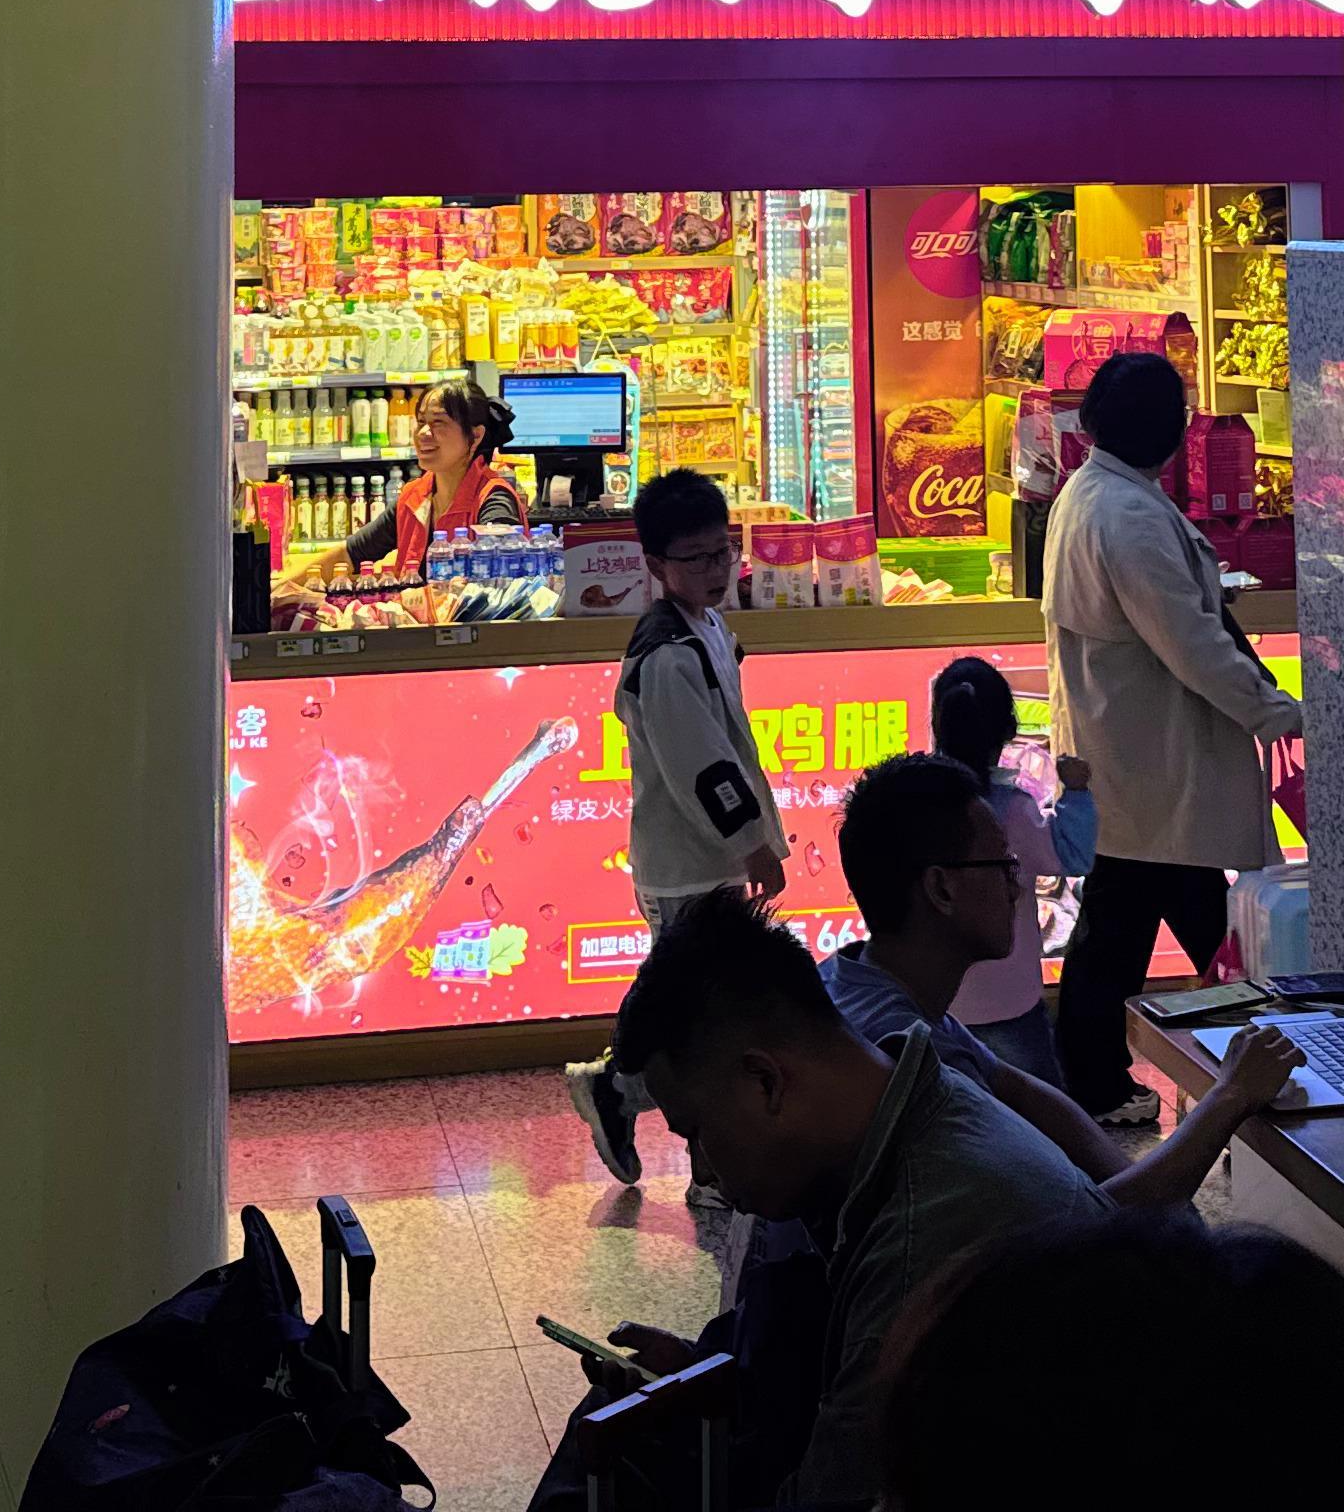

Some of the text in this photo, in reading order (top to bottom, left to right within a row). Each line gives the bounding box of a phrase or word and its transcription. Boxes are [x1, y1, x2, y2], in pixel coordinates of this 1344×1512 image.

[910, 230, 981, 260] 可口可
[902, 320, 964, 341] 这感觉
[908, 464, 985, 519] Coca
[249, 736, 269, 749] KE
